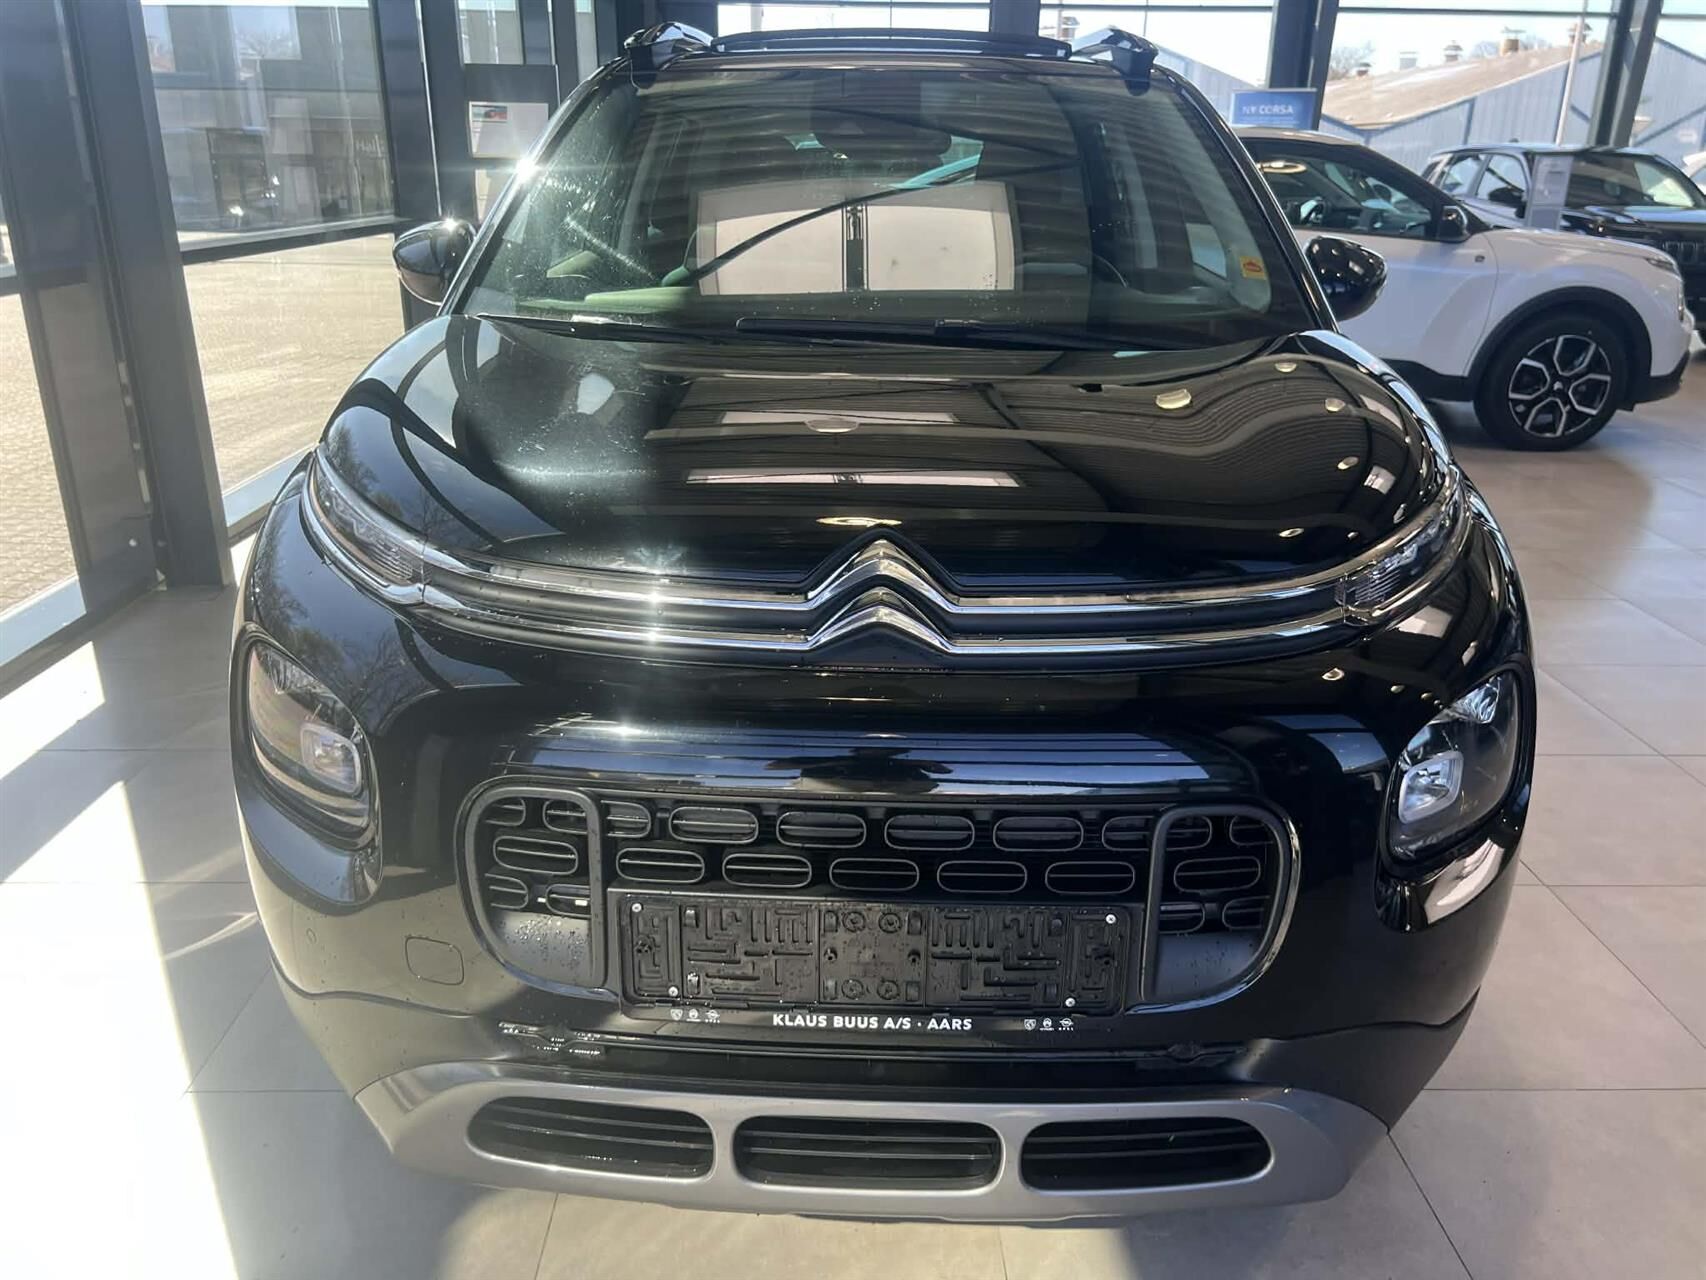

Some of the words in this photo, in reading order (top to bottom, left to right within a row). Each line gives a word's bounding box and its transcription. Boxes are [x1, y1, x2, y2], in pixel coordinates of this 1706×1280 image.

[773, 1014, 827, 1027] KLAUS
[833, 1016, 879, 1029] BUUS
[884, 1017, 912, 1030] A/S
[927, 1018, 973, 1031] AARS
